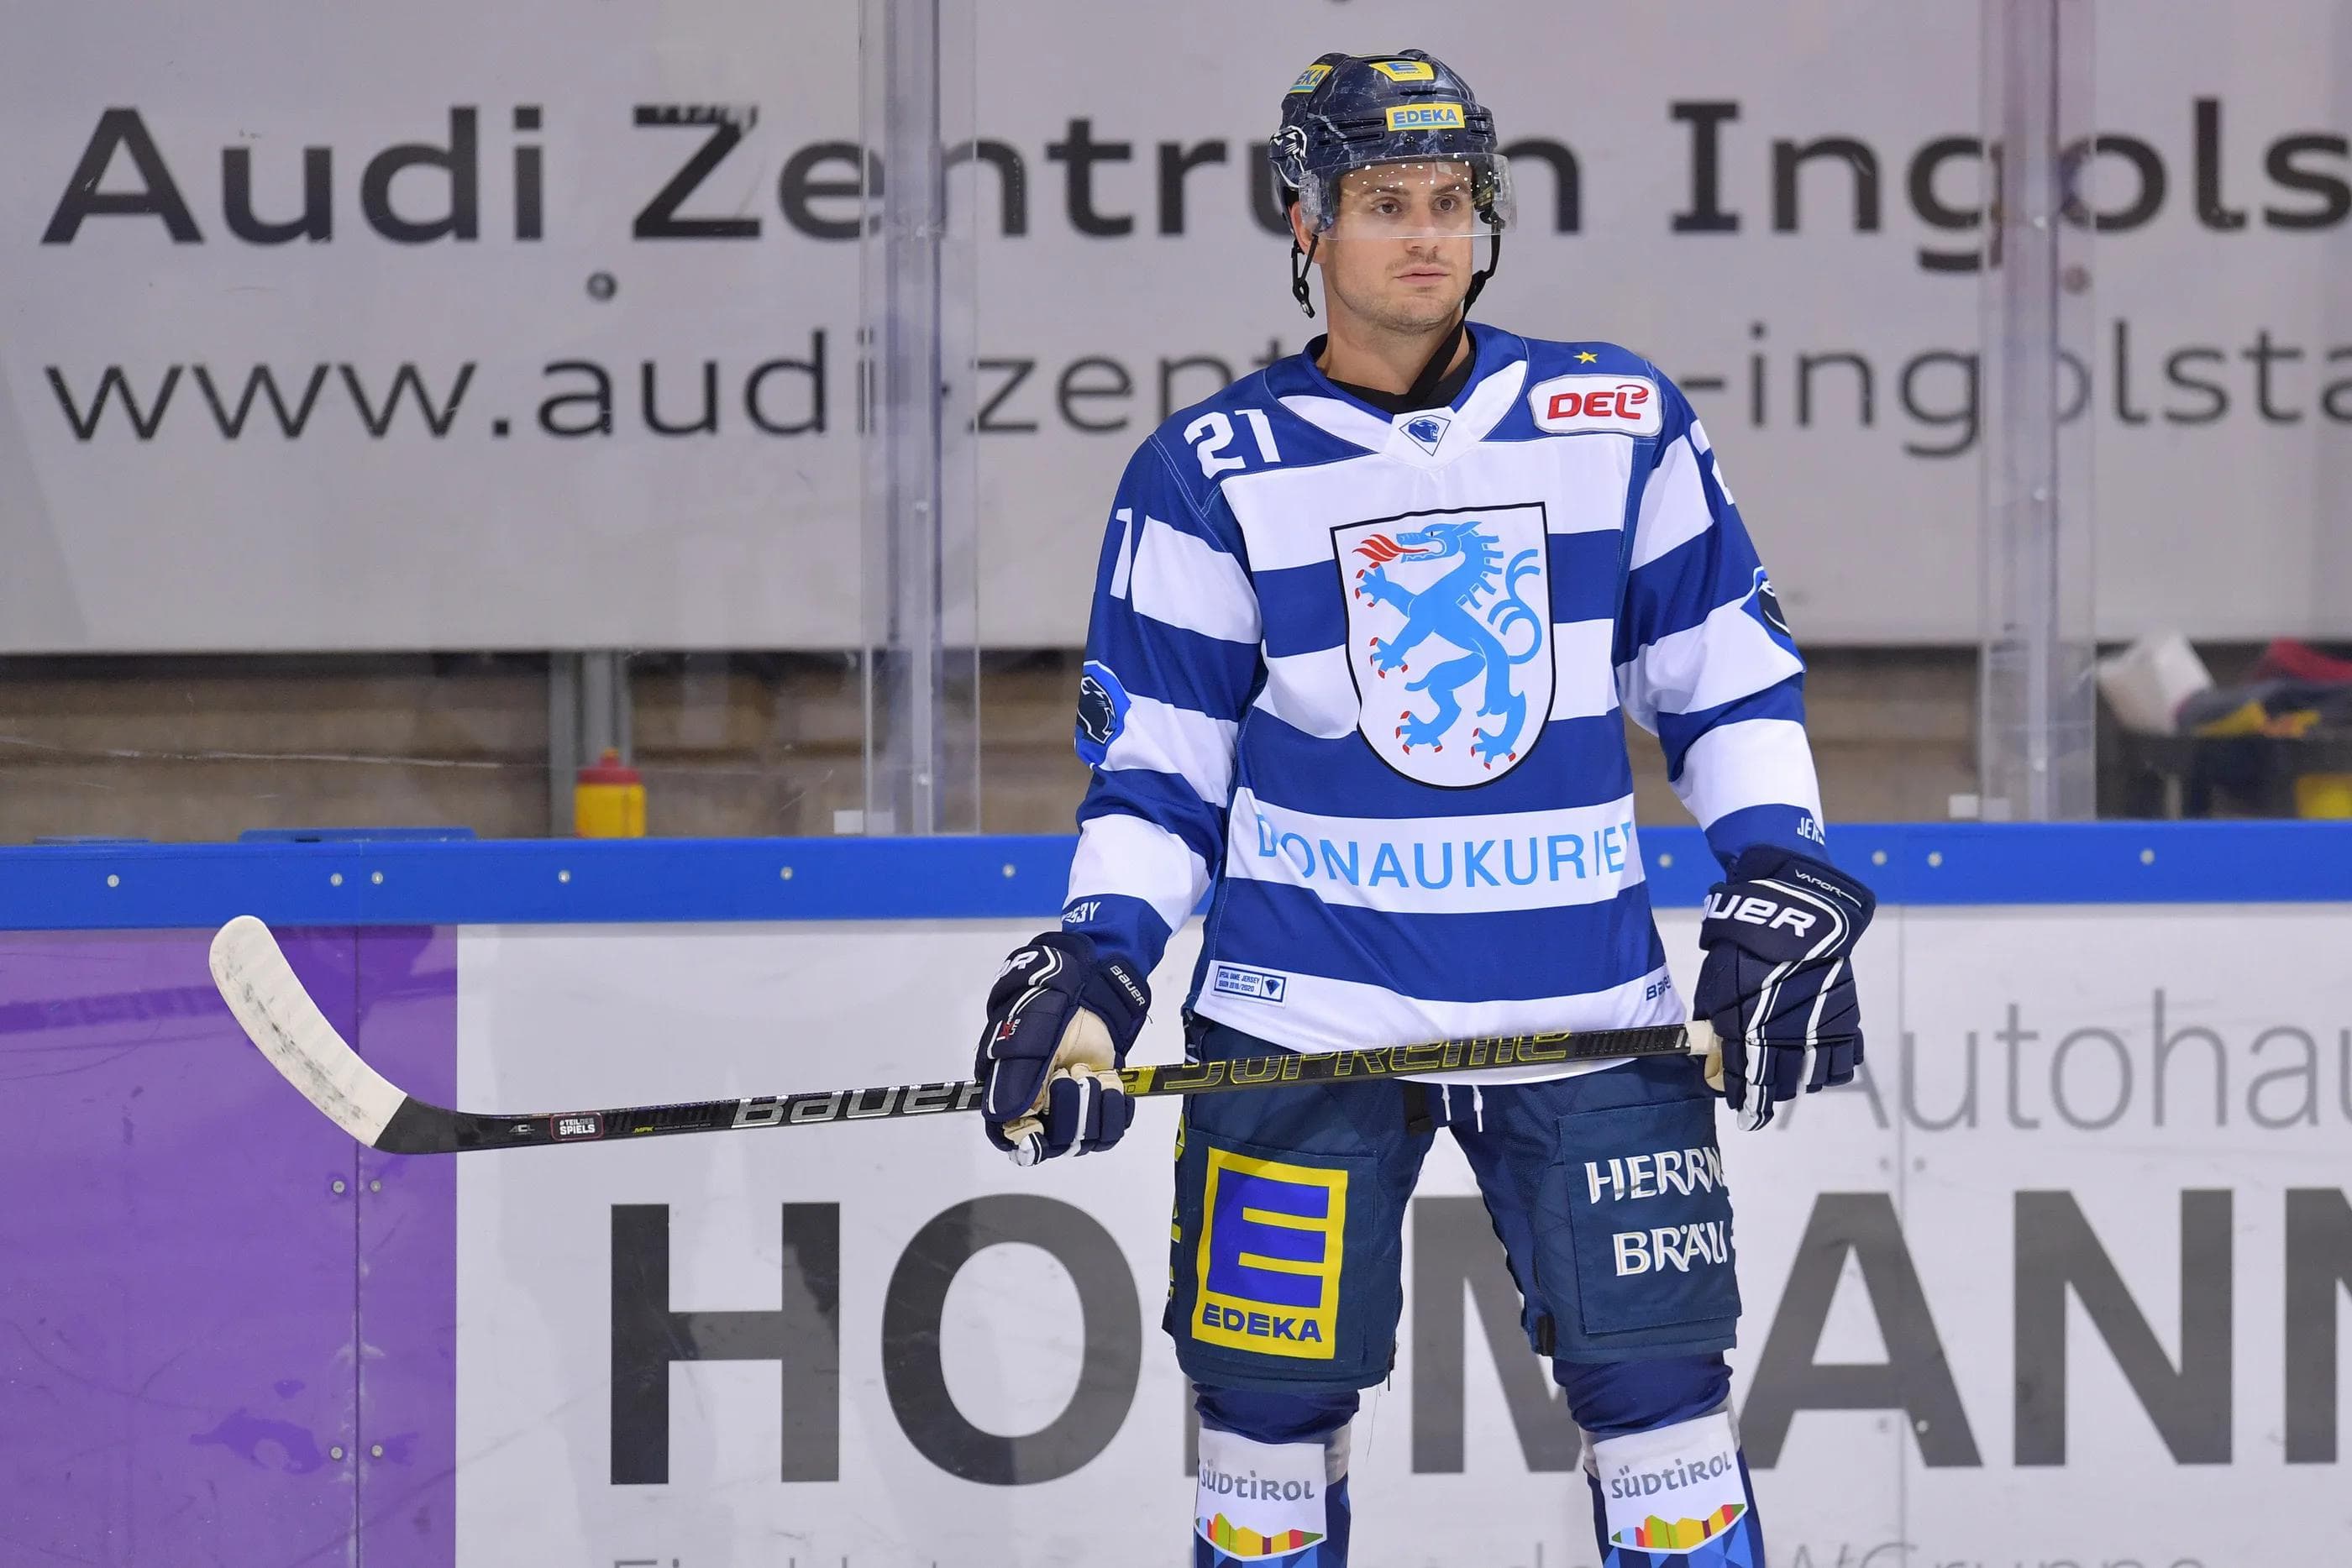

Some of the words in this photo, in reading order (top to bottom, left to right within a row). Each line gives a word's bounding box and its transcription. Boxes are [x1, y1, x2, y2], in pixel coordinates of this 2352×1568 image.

[1393, 108, 1457, 124] EDEKA
[40, 105, 543, 245] Audi
[1669, 97, 2352, 273] Ingols
[1183, 408, 1282, 480] 21
[1775, 988, 2352, 1132] utoha
[559, 1124, 596, 1135] SPIELS
[1612, 1220, 1728, 1277] BRÄU
[611, 1188, 2352, 1487] HOMAN
[1202, 1303, 1323, 1342] EDEKA
